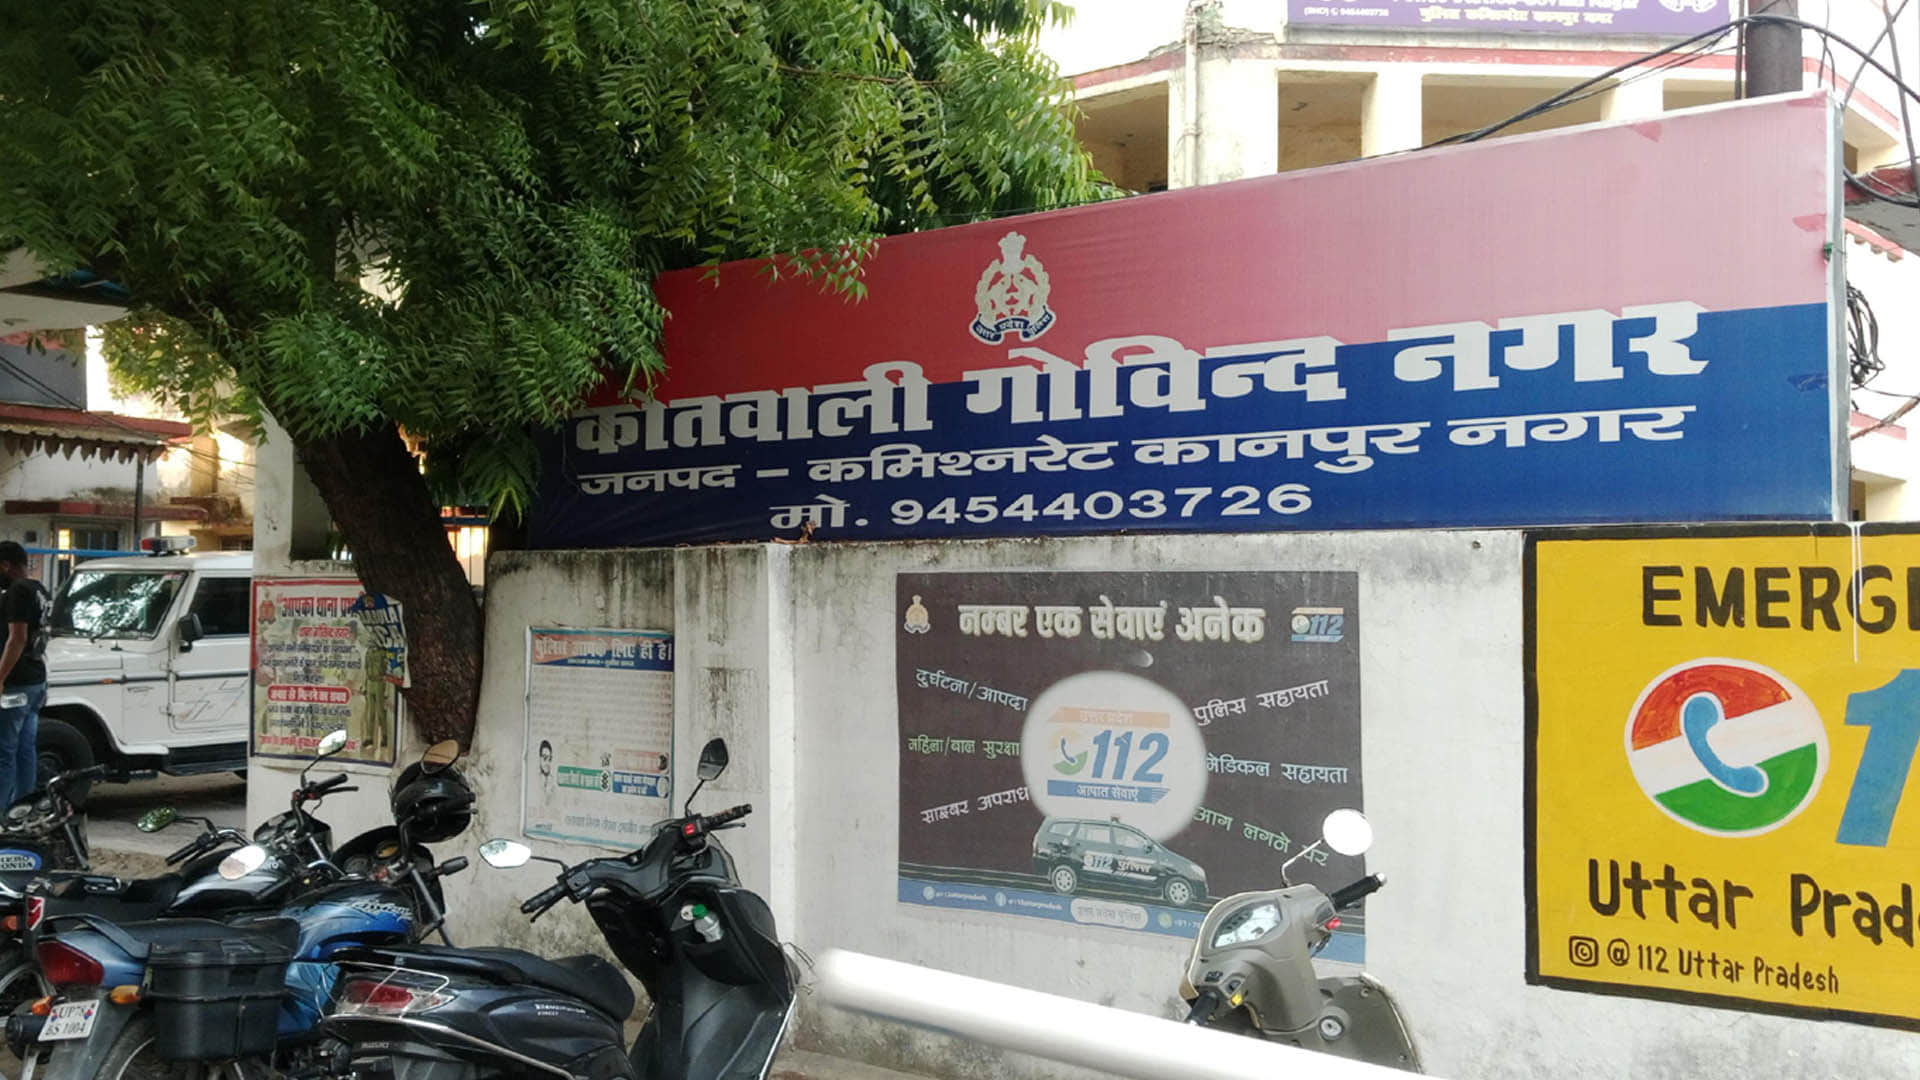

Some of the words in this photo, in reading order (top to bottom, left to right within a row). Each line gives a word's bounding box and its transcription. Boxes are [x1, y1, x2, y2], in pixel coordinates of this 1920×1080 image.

[569, 360, 933, 454] कोतवाली
[962, 335, 1347, 424] गोविन्द
[1387, 300, 1710, 391] नगर
[577, 464, 741, 495] जनपद
[806, 433, 1119, 483] कमिश्नरेट
[1131, 421, 1431, 474] कानपुर
[1447, 405, 1697, 448] नगर
[890, 483, 1313, 525] 9454403726
[957, 605, 1030, 637] नम्बर
[1034, 605, 1083, 638] एक
[1175, 596, 1266, 642] अनेक
[1193, 697, 1247, 726] पुलिस
[1256, 680, 1329, 708] सहायता
[1091, 730, 1169, 783] 112
[1206, 752, 1270, 777] मेडिकल
[1281, 763, 1348, 784] सहायता
[977, 787, 1030, 811] अपराध
[1193, 806, 1234, 831] आग
[1243, 822, 1291, 853] लगने
[1589, 858, 1754, 930] Uttar
[1791, 872, 1920, 947] Prad
[1678, 948, 1746, 984] Uttar
[1754, 956, 1839, 995] Pradesh
